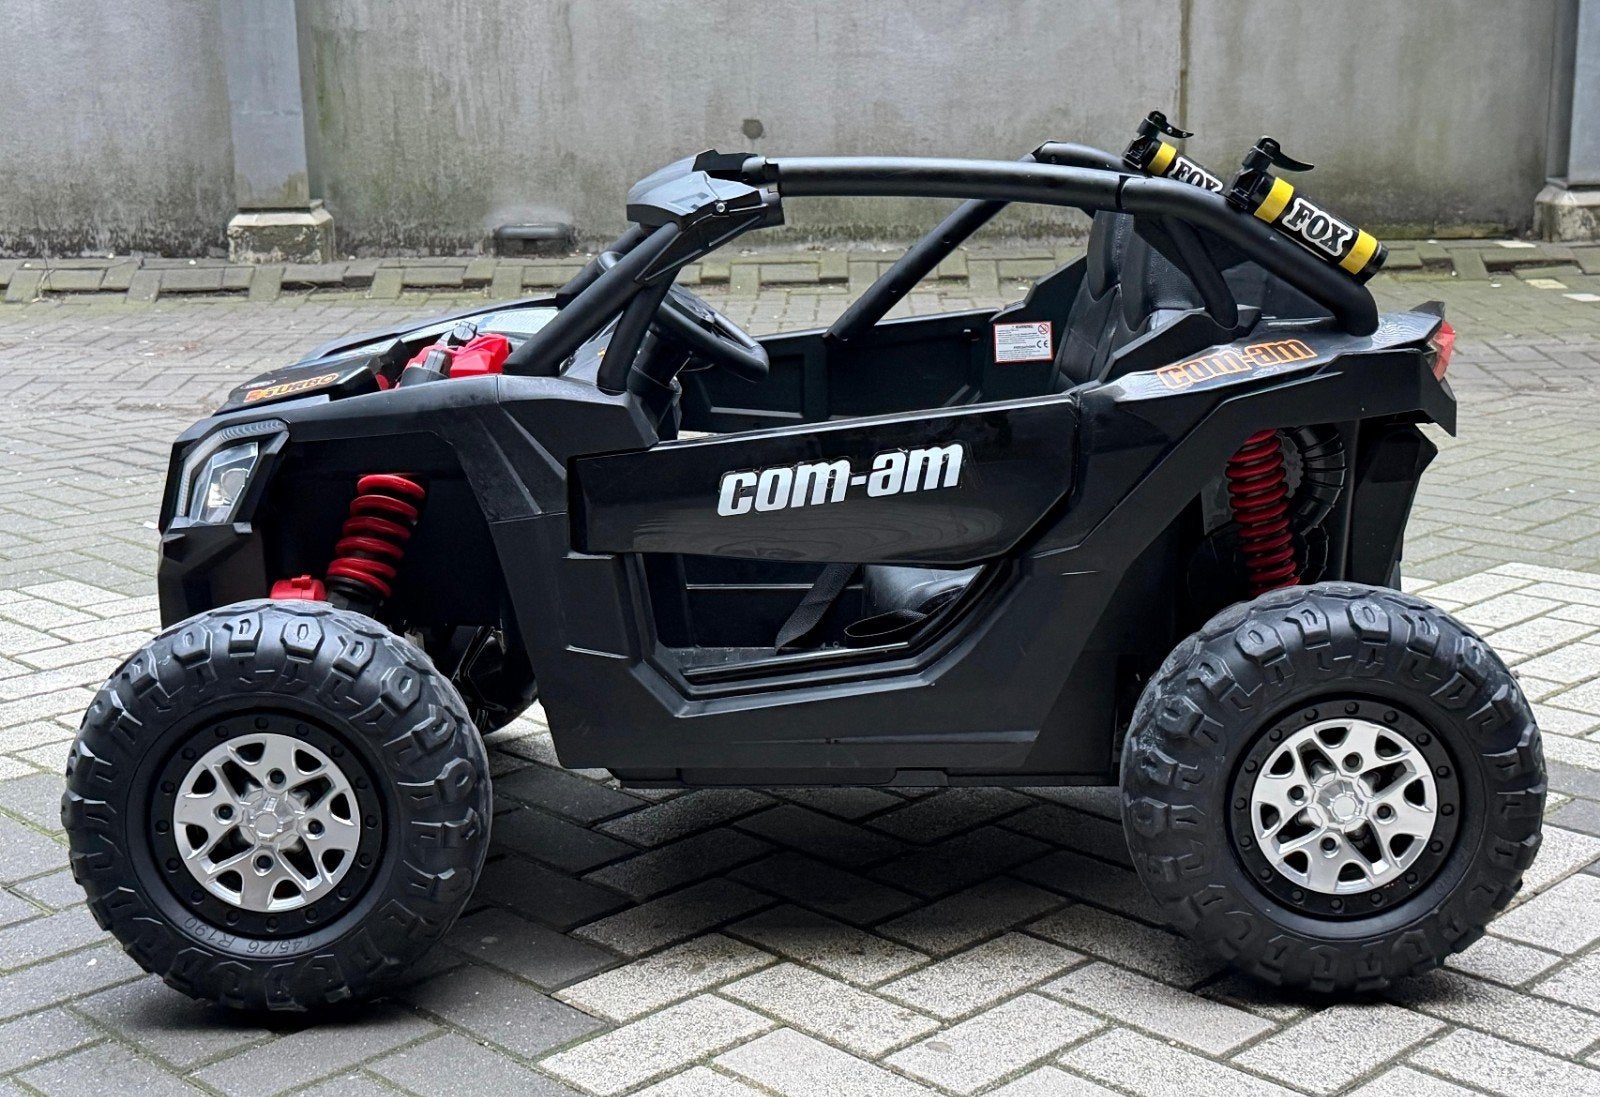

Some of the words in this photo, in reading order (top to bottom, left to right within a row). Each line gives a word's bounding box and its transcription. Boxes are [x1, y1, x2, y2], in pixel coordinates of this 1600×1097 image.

[1286, 201, 1350, 251] FOX
[1036, 340, 1049, 349] CE
[717, 443, 964, 517] com-am
[183, 915, 237, 949] R190
